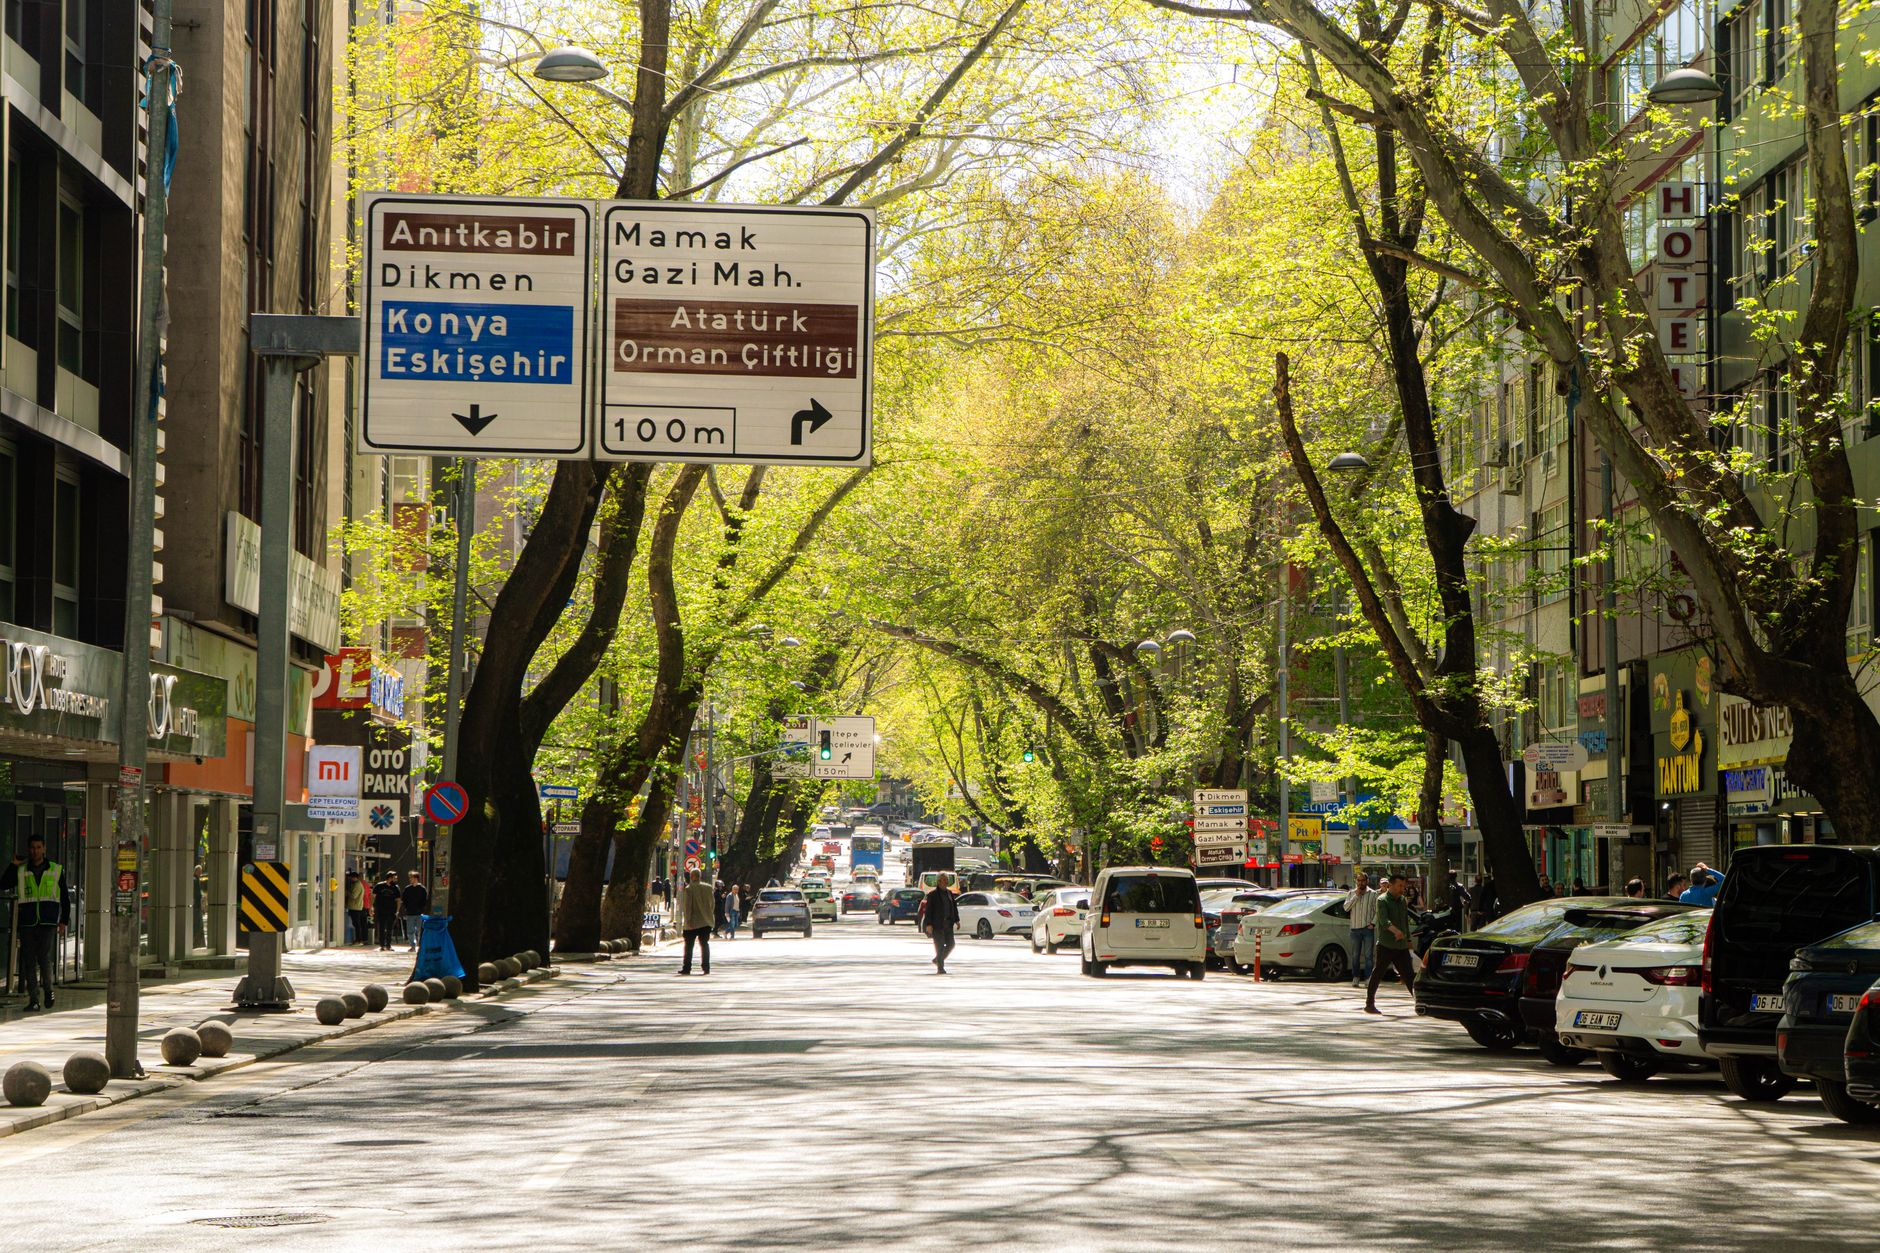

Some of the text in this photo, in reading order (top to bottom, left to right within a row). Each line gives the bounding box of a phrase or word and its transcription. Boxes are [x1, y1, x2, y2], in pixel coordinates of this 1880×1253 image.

[390, 219, 570, 249] Anıtkabir
[615, 221, 757, 251] Mamak
[382, 263, 533, 292] Dikmen
[615, 259, 802, 288] Gazi Mah.
[388, 308, 507, 342] Konya
[670, 306, 808, 333] Atatürk
[387, 347, 566, 381] Eskişehir
[619, 339, 853, 374] Orman Çiftliği
[614, 418, 725, 444] 100m
[49, 654, 67, 679] HOTEL
[178, 707, 200, 739] HOTEL
[369, 749, 405, 770] OTO
[364, 774, 409, 794] PARK
[1296, 828, 1309, 837] Ptt
[1756, 997, 1767, 1009] 06
[1832, 996, 1844, 1010] 06
[1606, 1015, 1619, 1026] 163
